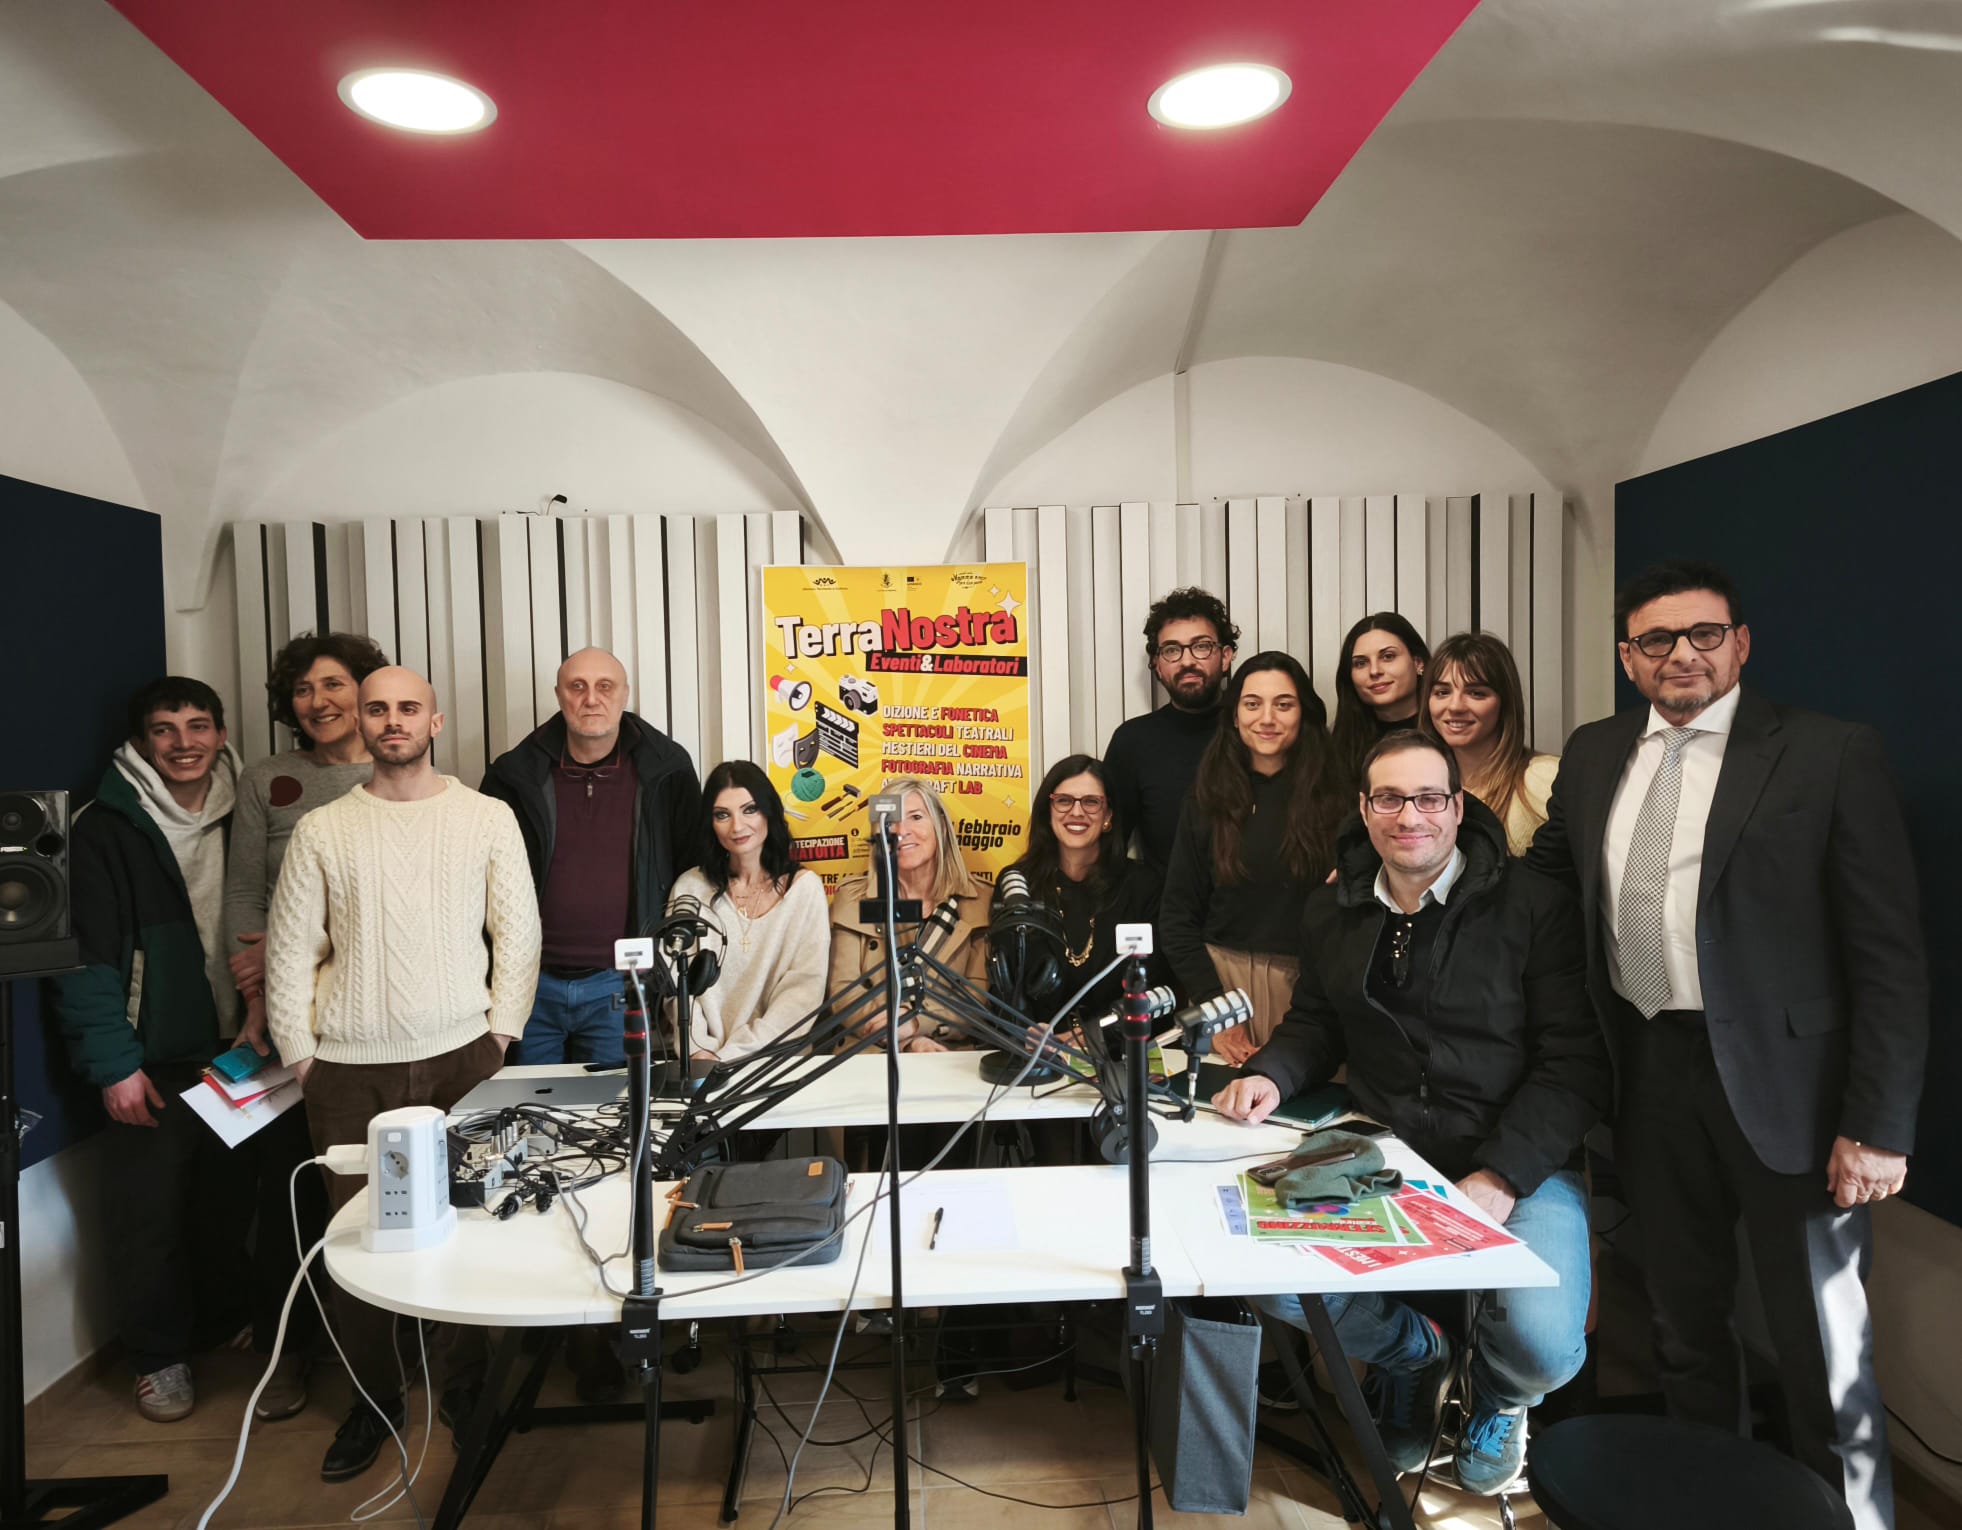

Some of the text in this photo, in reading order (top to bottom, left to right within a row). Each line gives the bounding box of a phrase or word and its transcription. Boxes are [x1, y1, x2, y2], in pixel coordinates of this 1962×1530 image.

[883, 705, 999, 722] DIZIONE E FONETICA
[882, 723, 1014, 741] SPETTACOLI TEATRALI
[882, 741, 1007, 759] MESTIERI DEL CINEMA
[881, 759, 1023, 778] FOTOGRAFIA NARRATIVA
[958, 780, 983, 795] LAB
[958, 818, 1021, 836] febbraio
